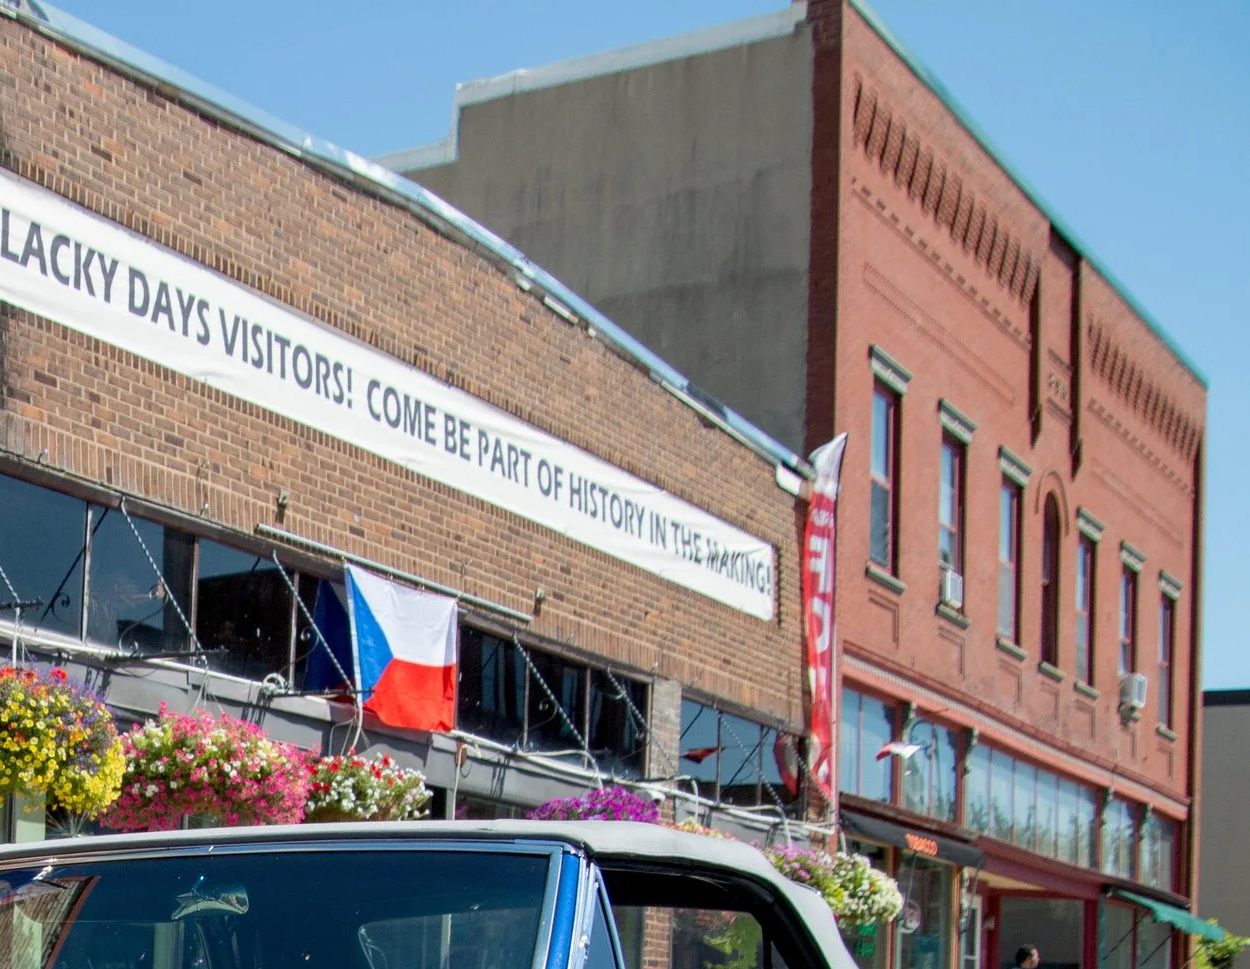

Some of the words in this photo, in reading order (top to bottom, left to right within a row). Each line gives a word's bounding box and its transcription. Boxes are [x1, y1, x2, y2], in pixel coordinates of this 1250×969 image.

[128, 265, 211, 347] DAYS
[219, 306, 354, 409] VISITORS!
[367, 379, 437, 446] COME
[444, 412, 471, 462] BE
[478, 428, 532, 488] PART
[537, 457, 564, 501] OF
[569, 471, 646, 540] HISTORY
[650, 510, 668, 550] IN
[671, 521, 703, 565] THE
[706, 537, 772, 597] MAKING!
